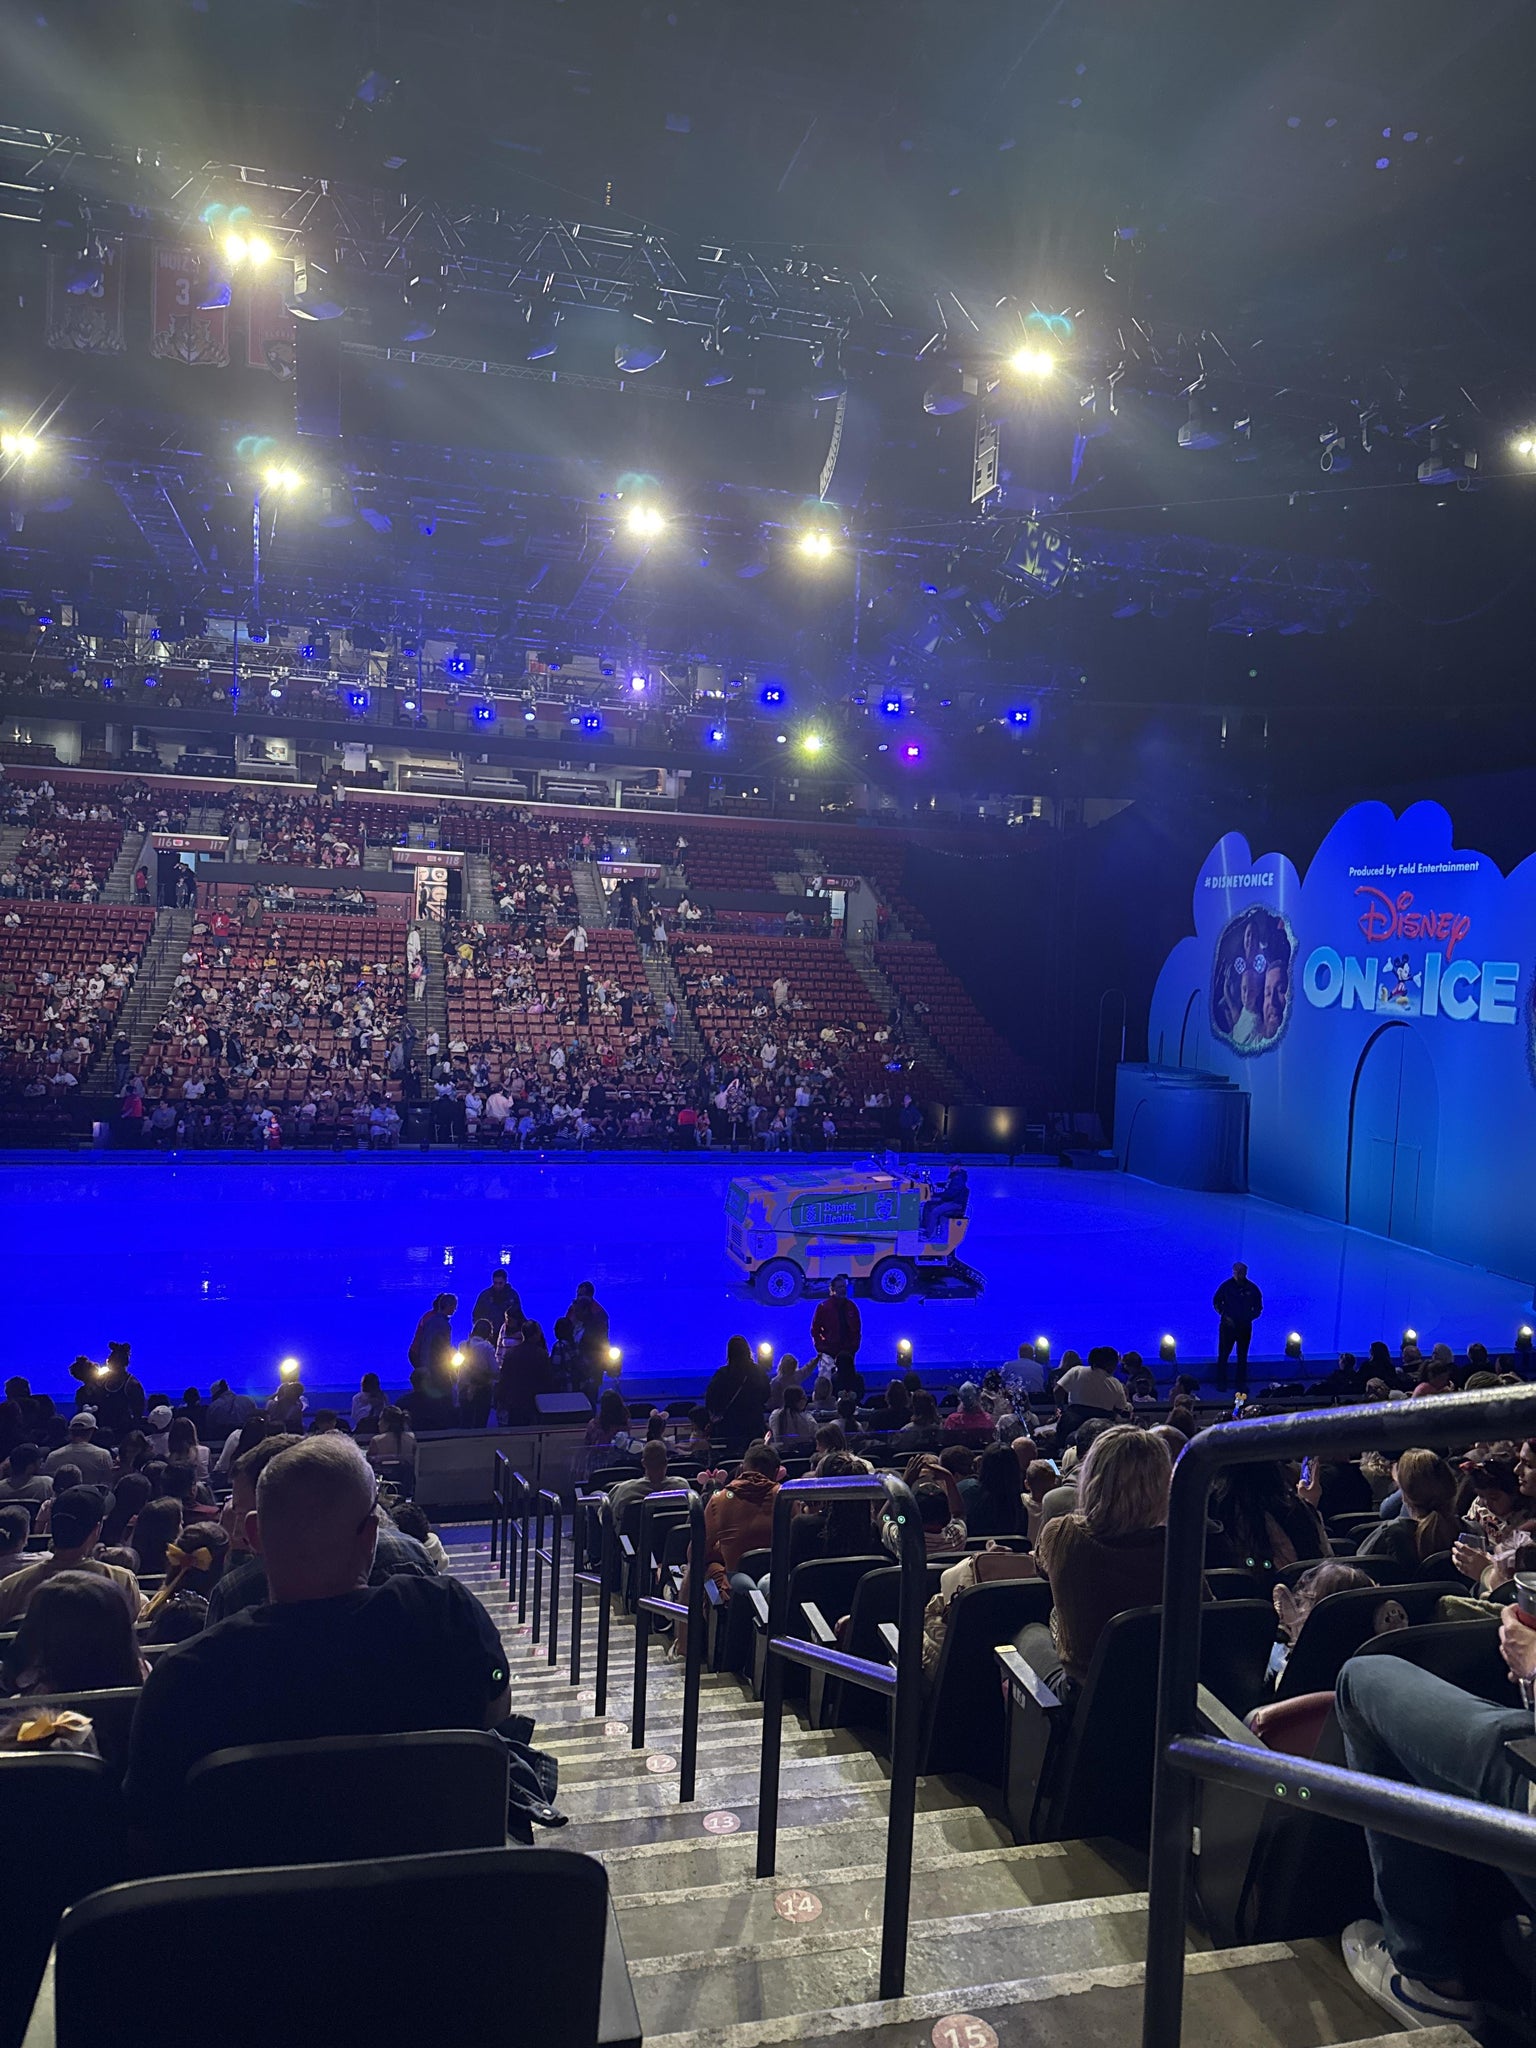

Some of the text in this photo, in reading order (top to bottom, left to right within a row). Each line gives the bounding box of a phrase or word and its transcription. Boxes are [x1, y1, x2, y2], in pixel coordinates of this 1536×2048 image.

[158, 838, 224, 850] 116 117
[396, 852, 460, 865] 117 118
[644, 867, 657, 877] 119
[1349, 861, 1479, 877] Produced by Feld Entertainment
[841, 878, 854, 887] 120
[1204, 873, 1274, 889] #DISNEYONICE
[1303, 946, 1520, 1025] ON ICE
[823, 1201, 856, 1213] Baptist
[823, 1213, 856, 1224] Health
[652, 1758, 672, 1768] 12
[710, 1816, 734, 1829] 13
[782, 1896, 815, 1916] 14
[943, 2024, 988, 2048] 15
